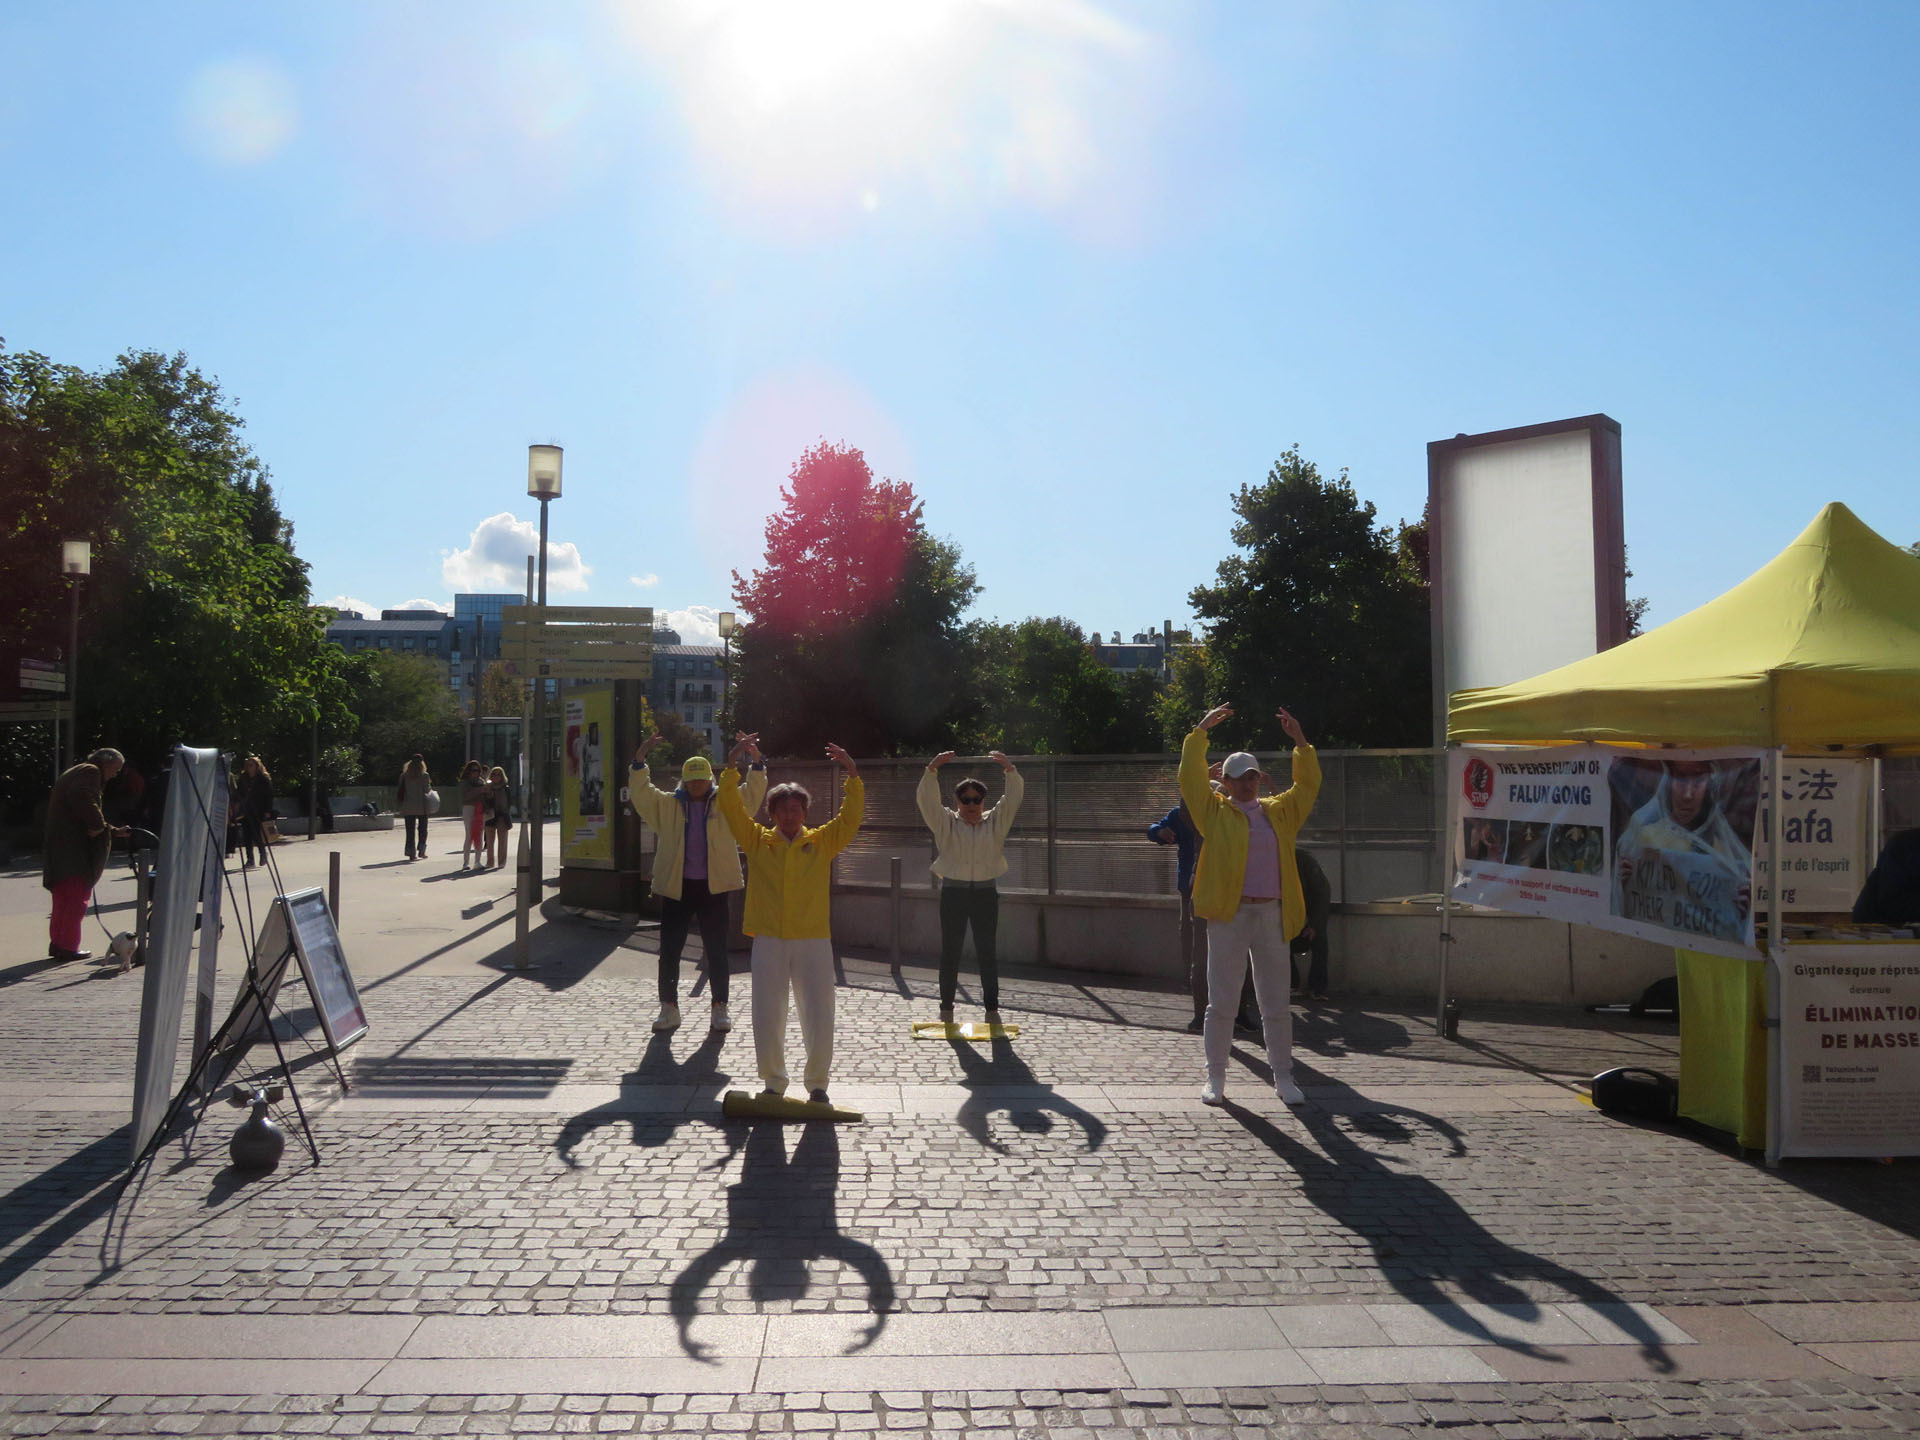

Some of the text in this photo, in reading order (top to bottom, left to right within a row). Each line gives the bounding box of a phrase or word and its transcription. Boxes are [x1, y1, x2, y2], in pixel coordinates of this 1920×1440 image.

[1497, 760, 1601, 775] THE PERSECUTION OF
[1471, 791, 1489, 802] STOP
[1509, 784, 1592, 805] FALUN GONG
[1795, 858, 1809, 871] de
[1812, 858, 1850, 874] l'esprit
[1631, 890, 1665, 922] THEIR
[1794, 964, 1877, 977] Gigantesque
[1850, 984, 1892, 994] devenue
[1805, 1004, 1920, 1022] ÉLIMINATIO
[1821, 1032, 1920, 1048] DE MASSE
